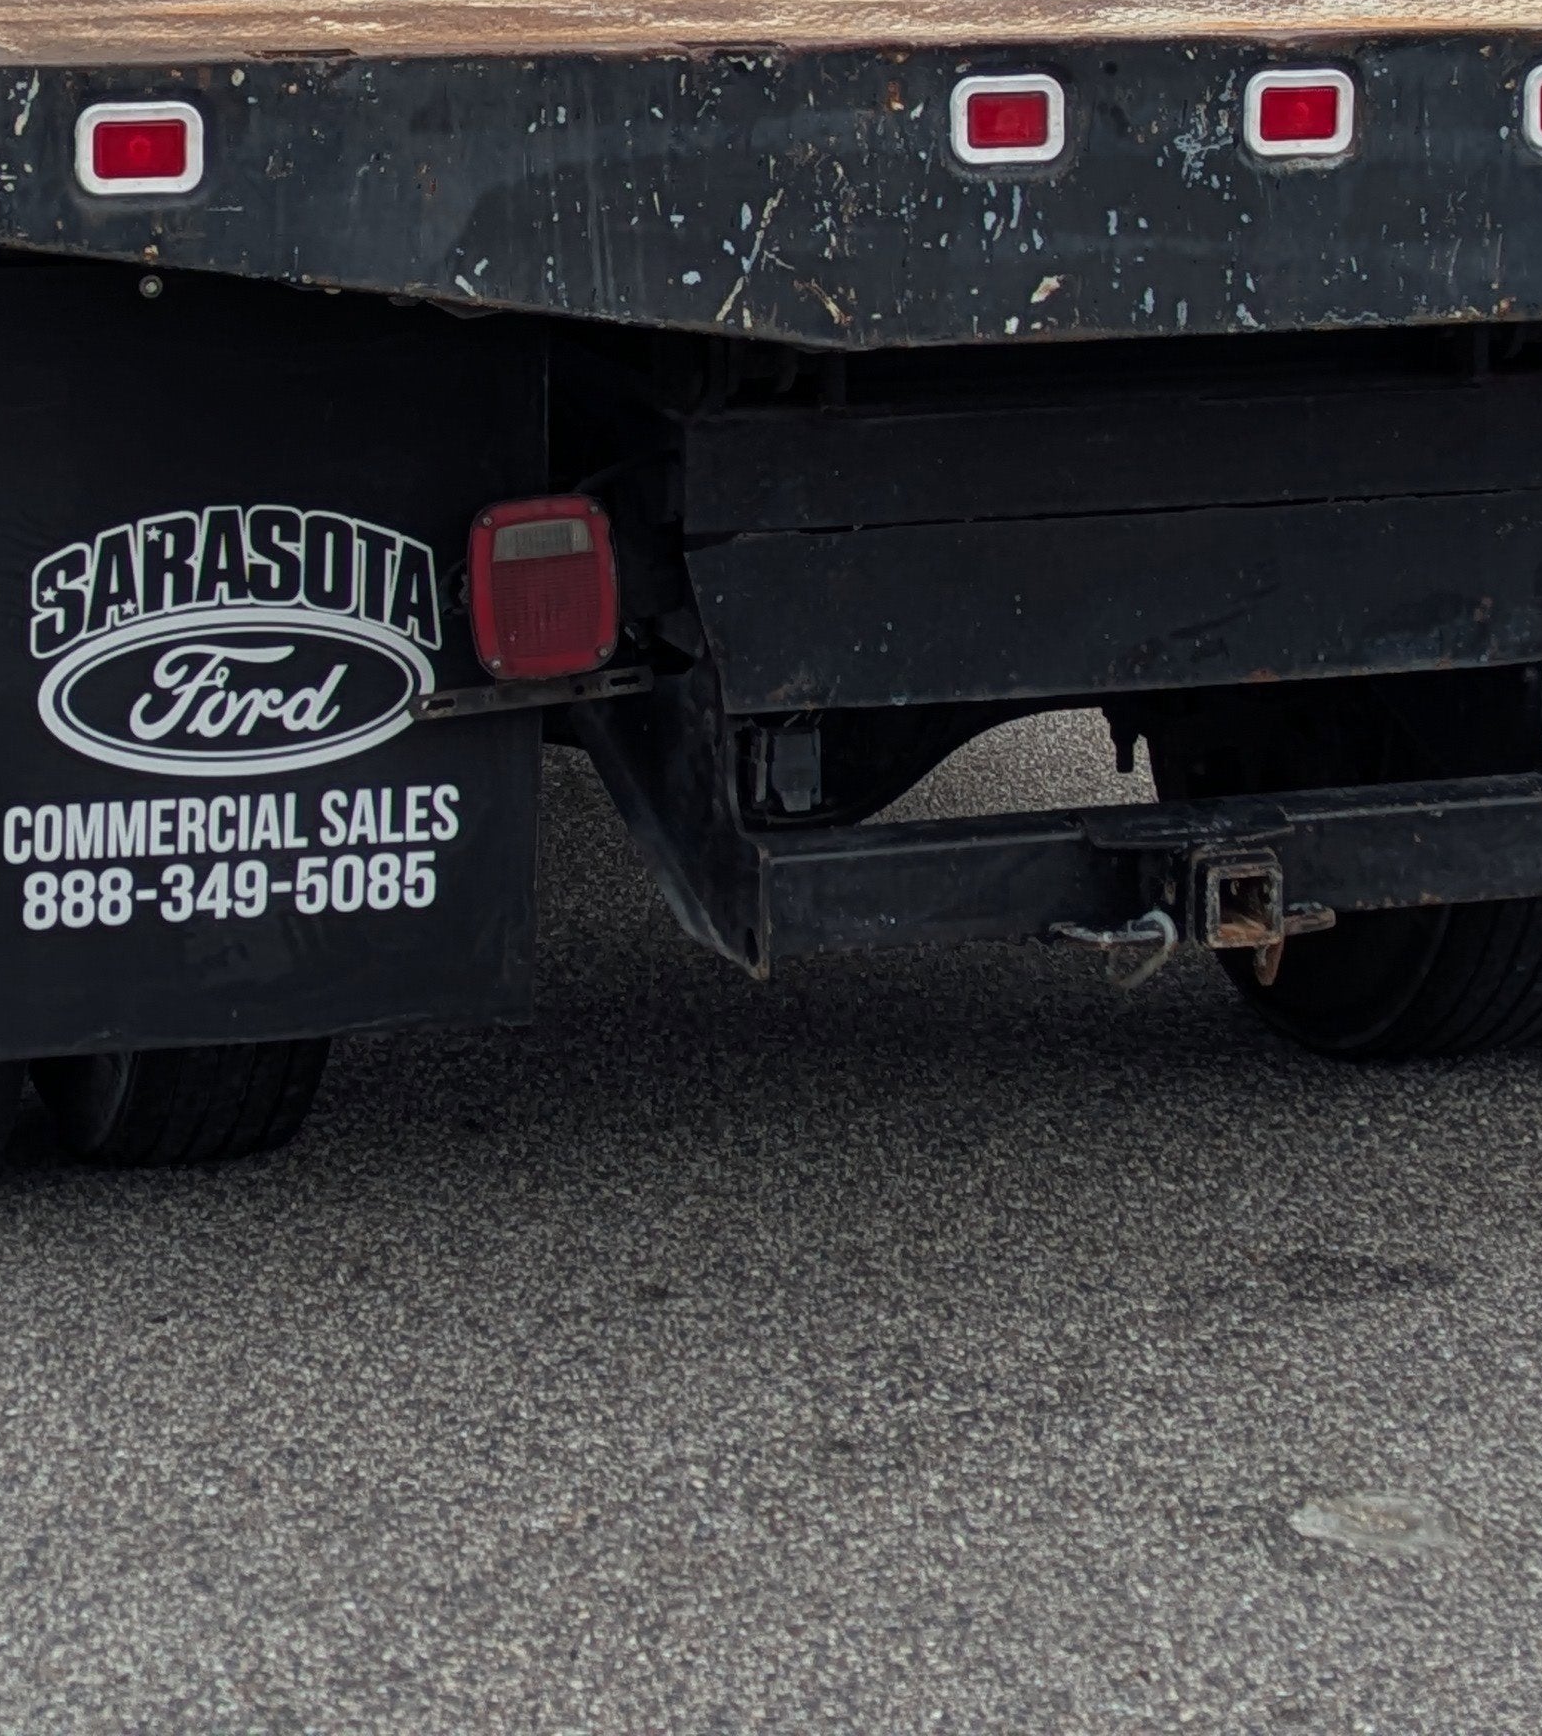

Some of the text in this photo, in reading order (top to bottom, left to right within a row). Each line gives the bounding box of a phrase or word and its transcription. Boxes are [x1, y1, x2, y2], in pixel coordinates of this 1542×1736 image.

[30, 504, 443, 659] SARASOTA
[130, 644, 347, 740] Ford
[3, 785, 459, 864] COMMERCIAL SALES
[22, 851, 436, 931] 888-349-5085
